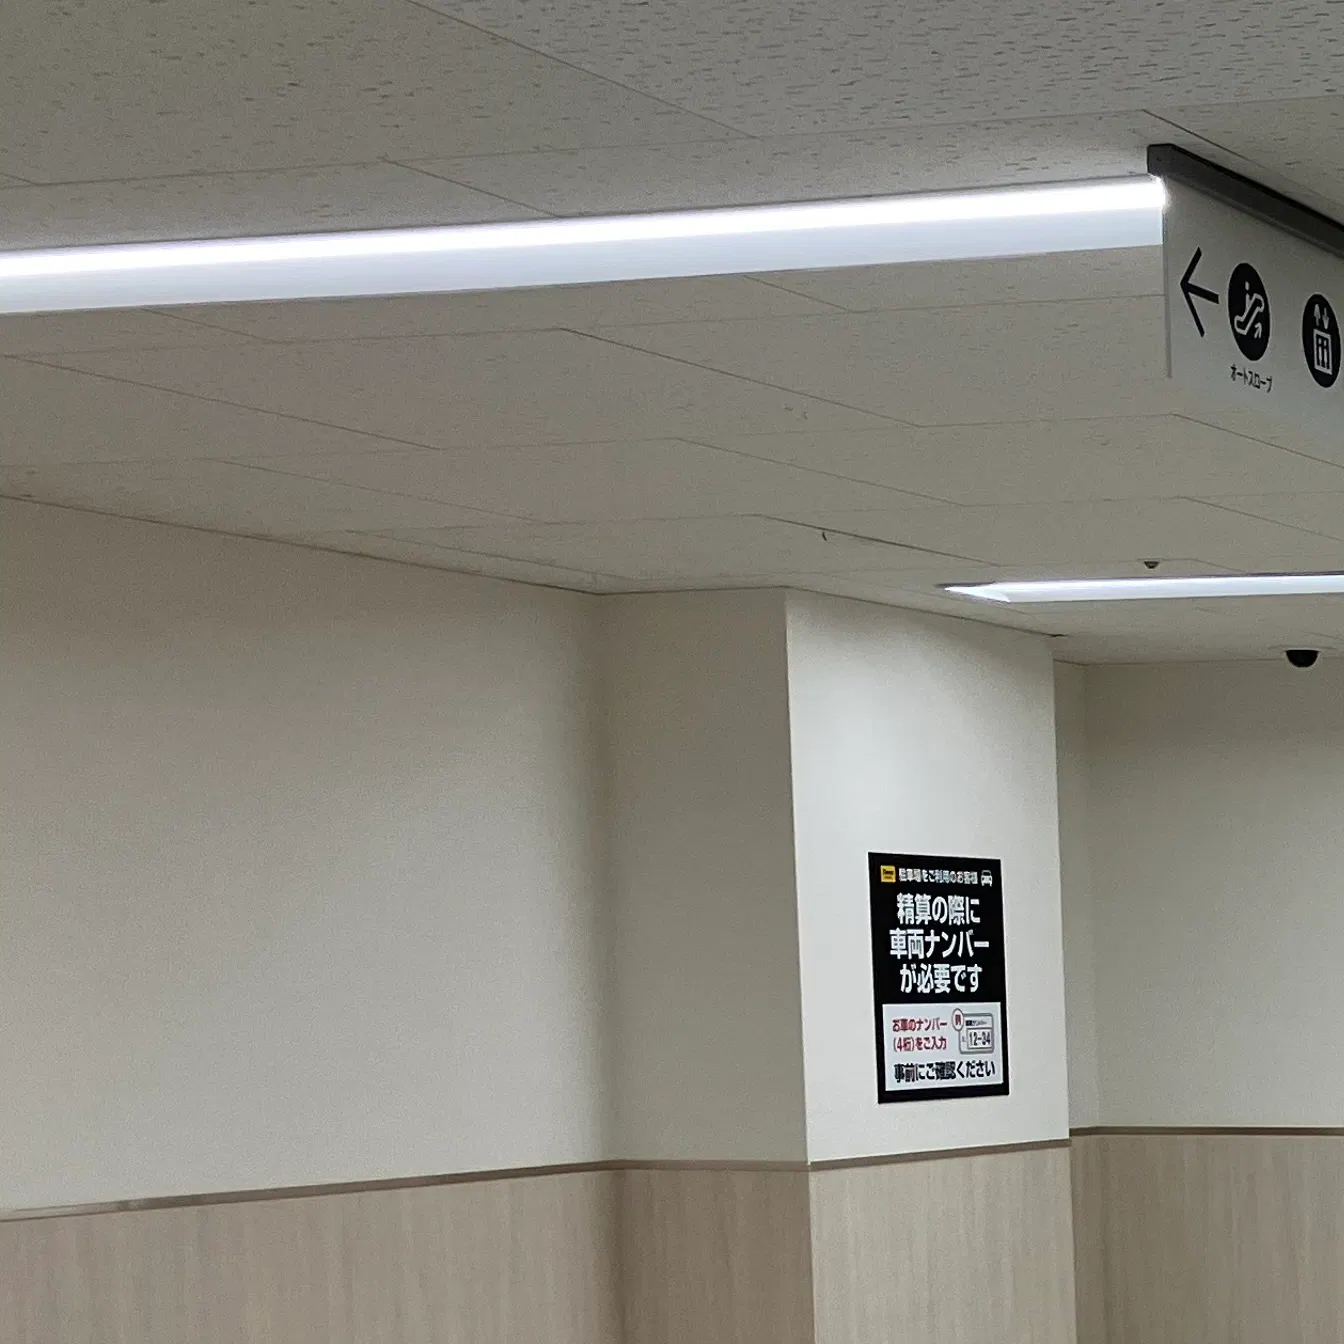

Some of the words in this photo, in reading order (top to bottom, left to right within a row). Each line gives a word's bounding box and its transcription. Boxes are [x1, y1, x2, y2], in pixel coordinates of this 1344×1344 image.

[1230, 362, 1273, 393] オートスロープ
[896, 892, 981, 926] 精算の際に
[888, 927, 990, 960] 車両ナンバー
[899, 962, 983, 994] が必要です
[892, 1017, 948, 1033] お車のナンバー
[893, 1059, 996, 1083] 事前にご確認ください
